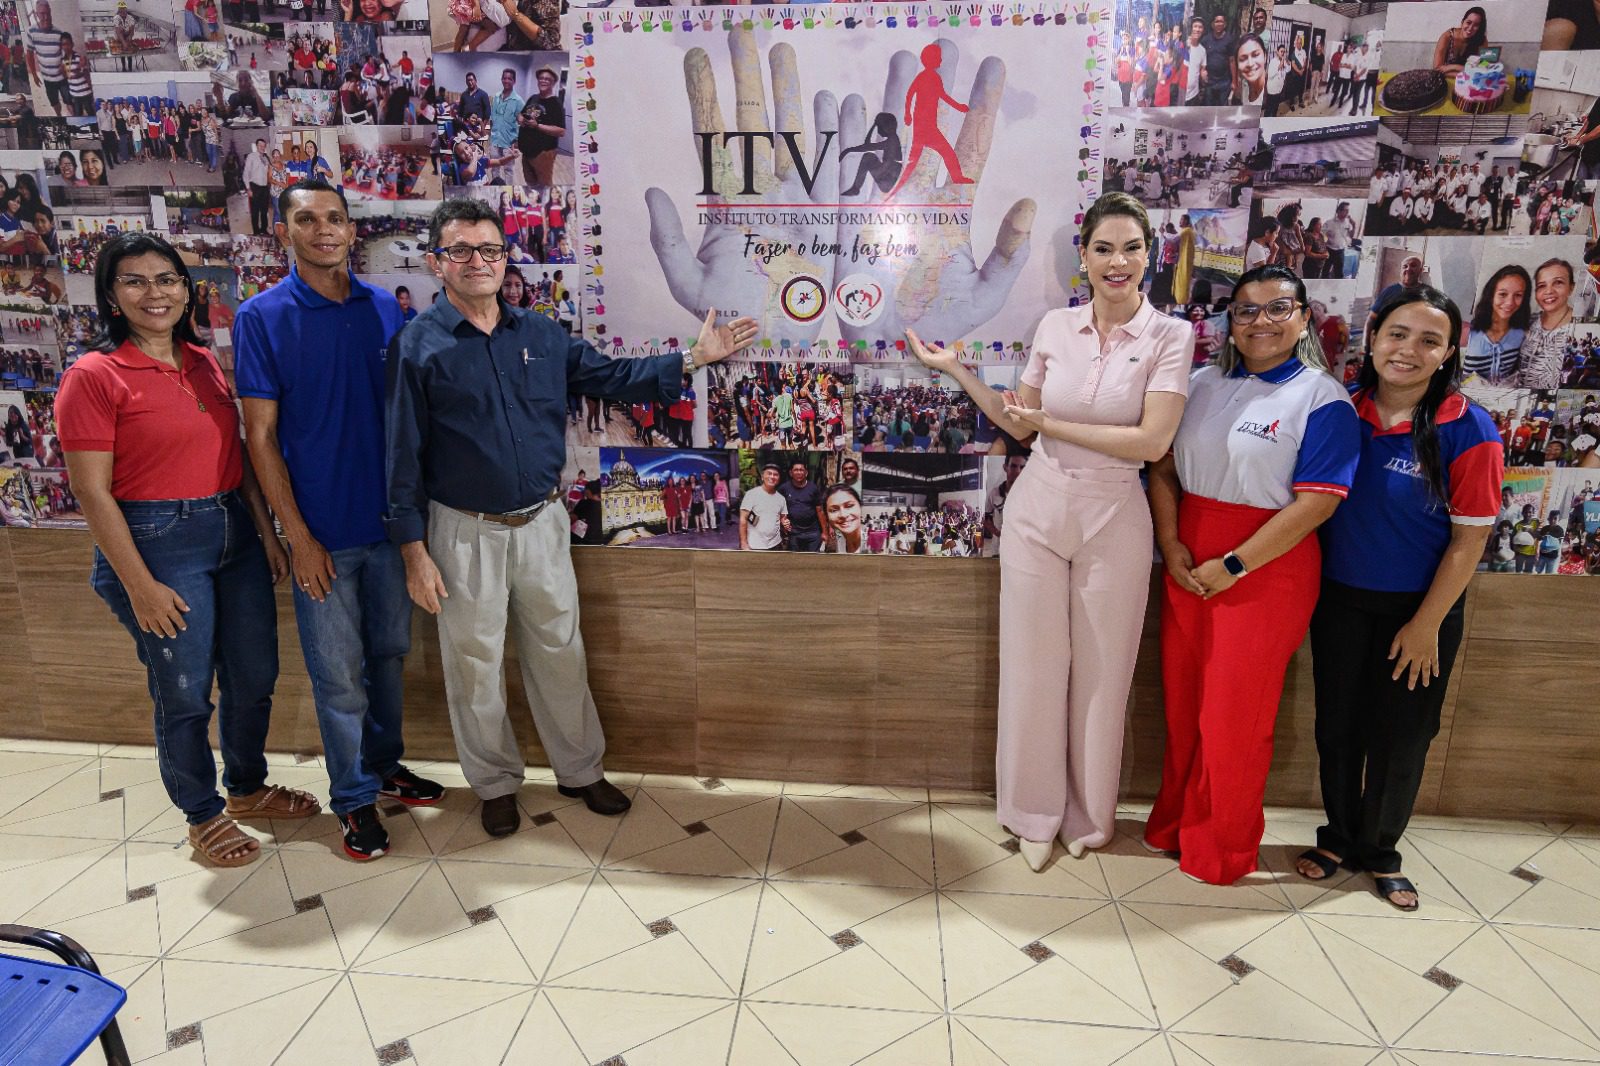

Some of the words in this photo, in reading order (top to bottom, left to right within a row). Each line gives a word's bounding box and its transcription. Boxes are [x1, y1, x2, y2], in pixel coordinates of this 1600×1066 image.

[698, 212, 777, 226] INSTITUTO
[780, 212, 918, 226] TRANSFORMANDO
[923, 212, 969, 226] VIDAS
[743, 233, 792, 264] Fazer
[797, 243, 807, 257] o
[811, 234, 847, 258] bem,
[851, 234, 881, 265] faz
[885, 234, 919, 257] bem
